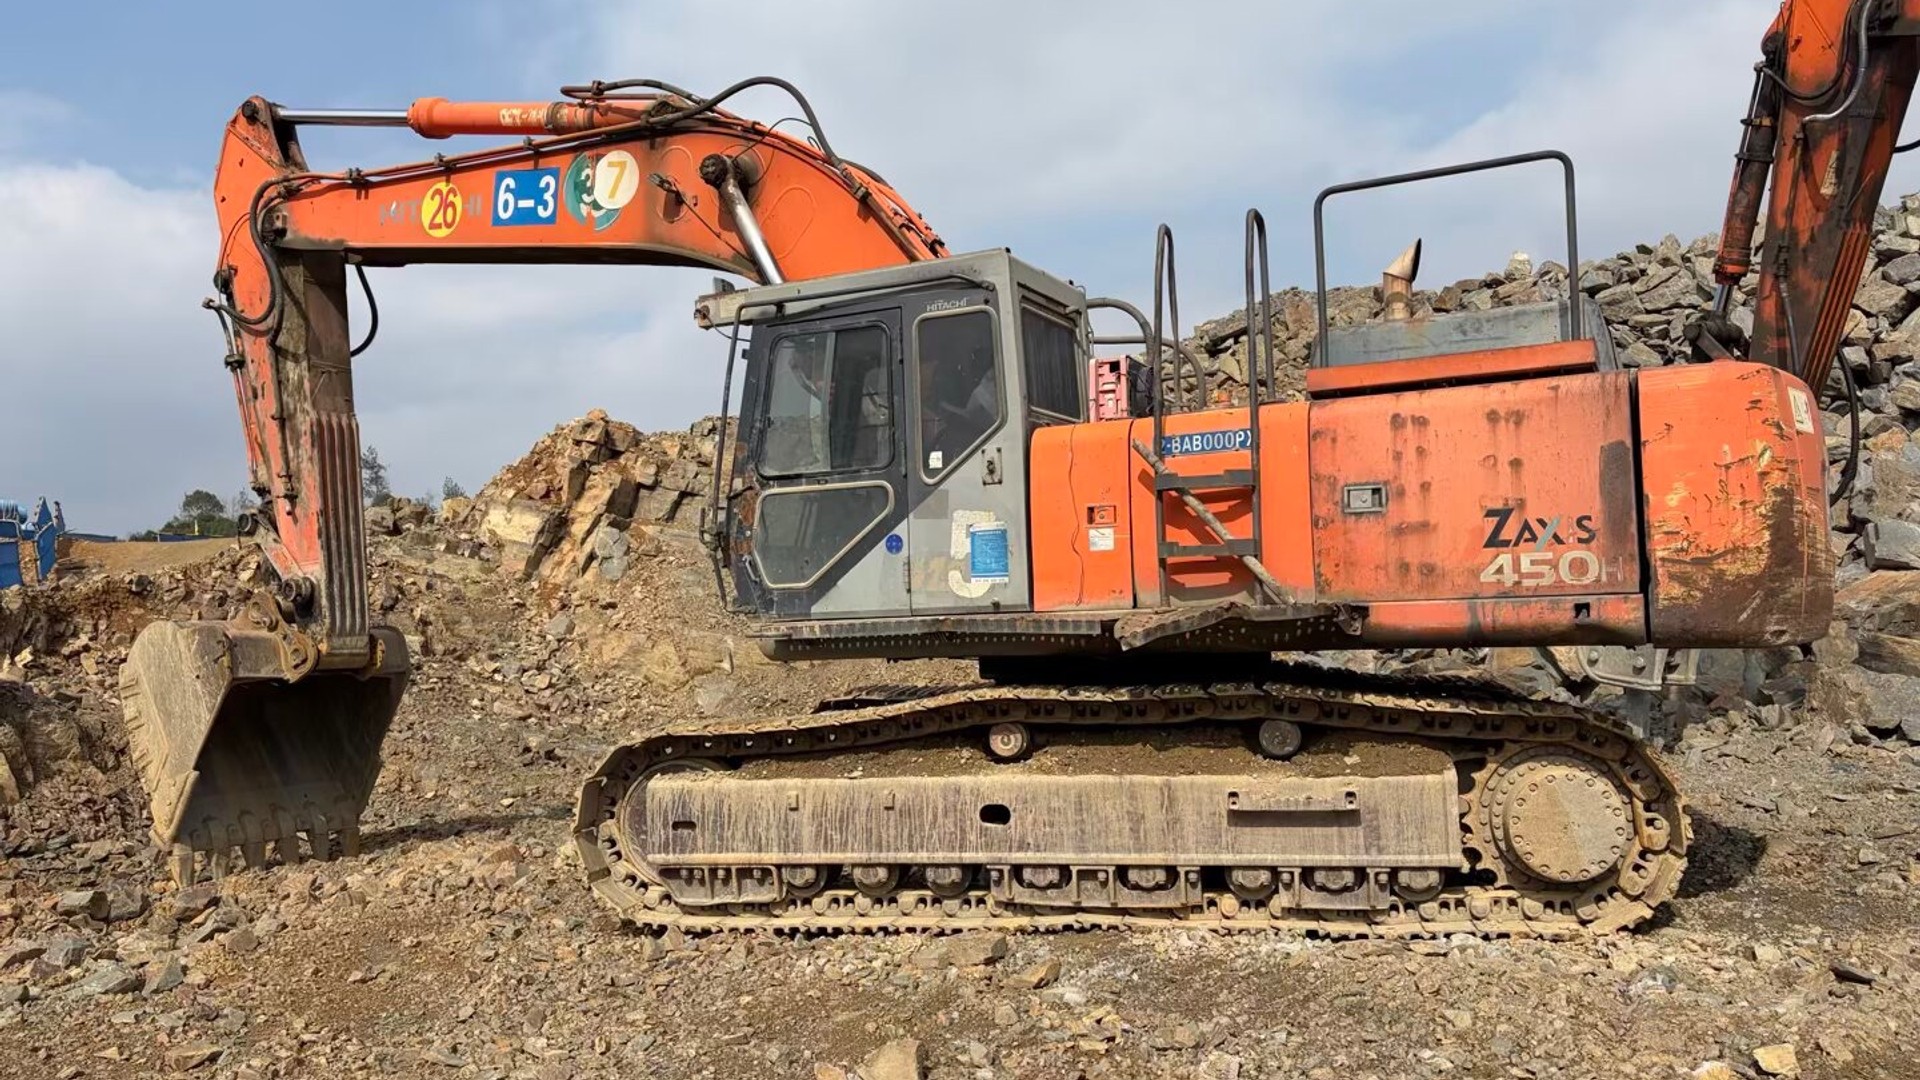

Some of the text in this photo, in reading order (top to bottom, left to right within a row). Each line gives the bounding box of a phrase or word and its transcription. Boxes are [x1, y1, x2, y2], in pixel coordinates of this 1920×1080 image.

[497, 174, 556, 220] 6-3
[606, 160, 628, 200] 7
[428, 187, 458, 230] 26
[926, 297, 967, 312] HITACHI
